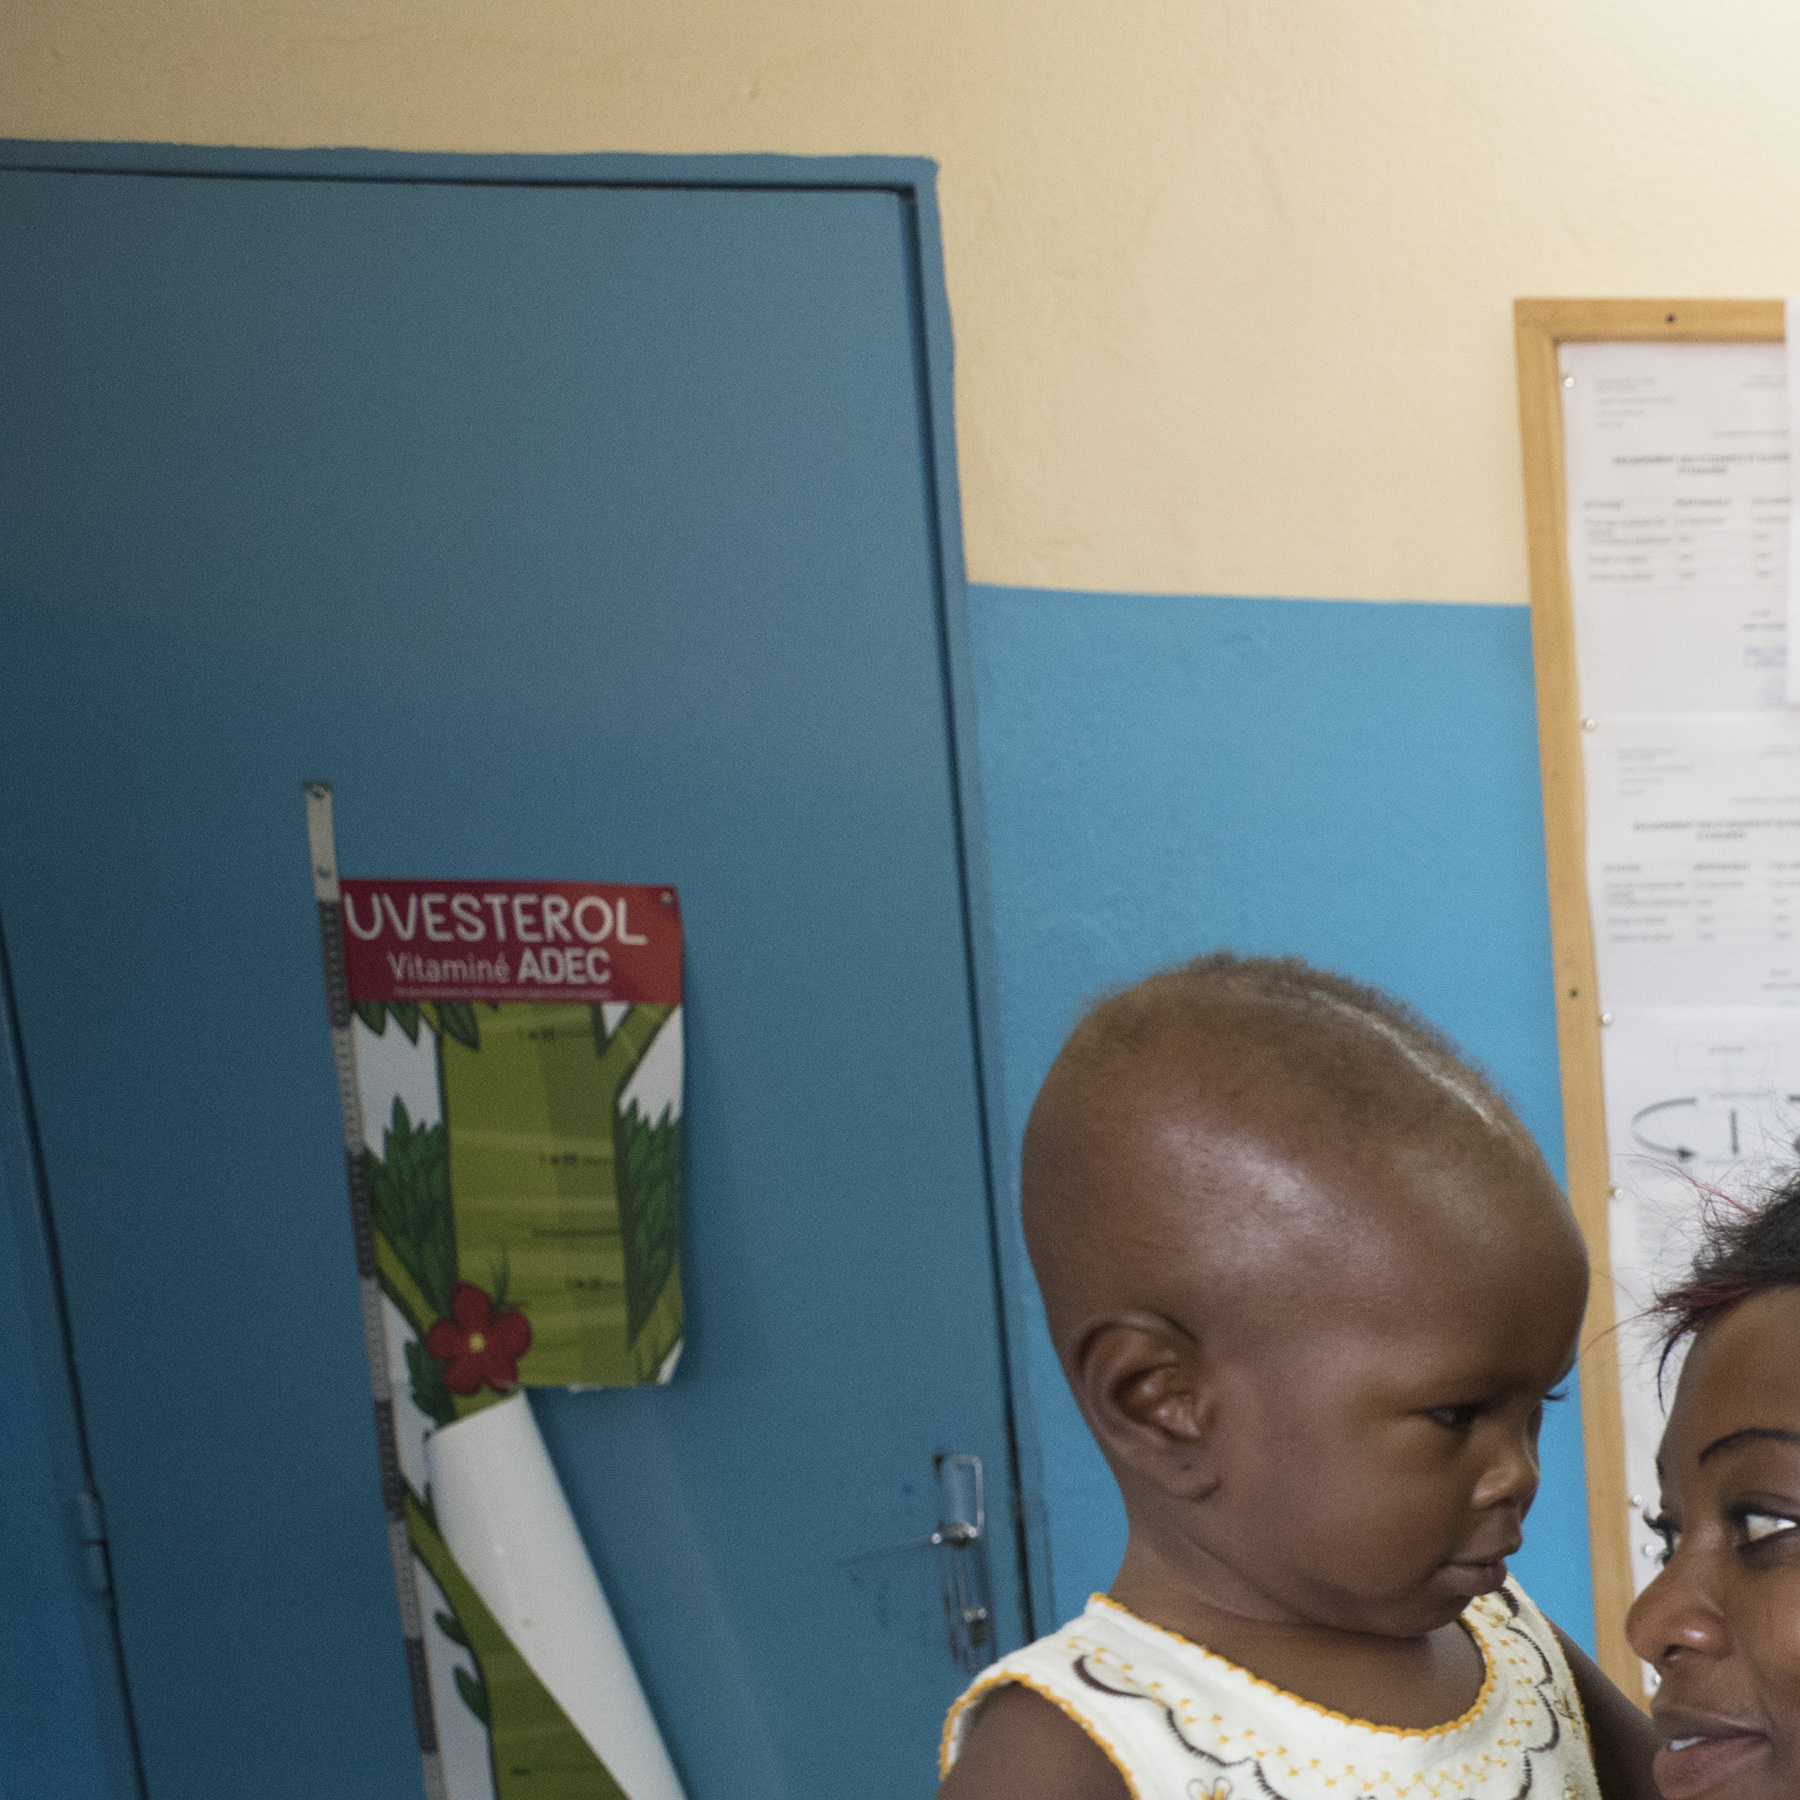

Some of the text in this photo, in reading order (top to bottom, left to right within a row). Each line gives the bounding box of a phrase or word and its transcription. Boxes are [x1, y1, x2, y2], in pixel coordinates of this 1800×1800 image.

[343, 891, 648, 946] UVESTEROL
[387, 946, 612, 985] Vitaminé ADEC
